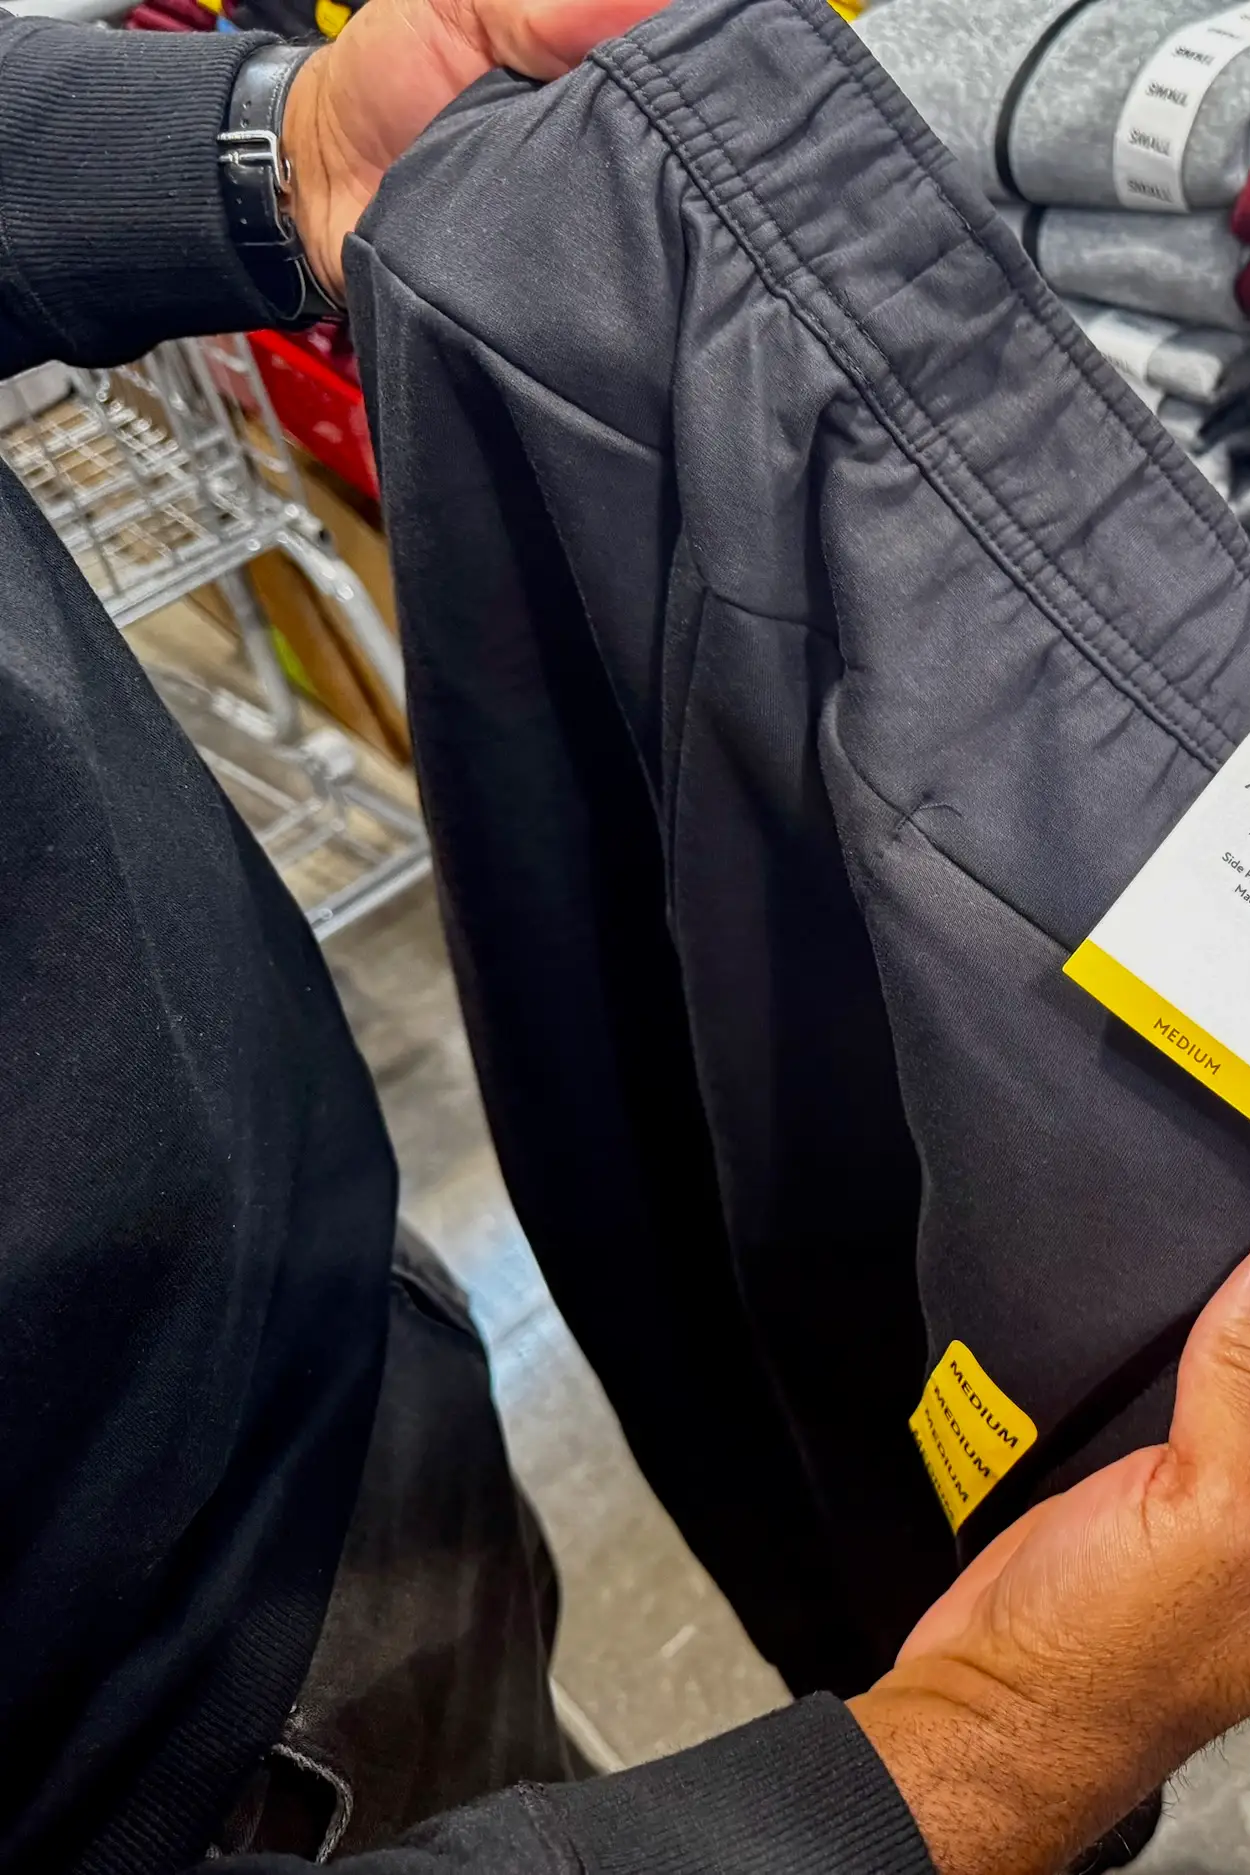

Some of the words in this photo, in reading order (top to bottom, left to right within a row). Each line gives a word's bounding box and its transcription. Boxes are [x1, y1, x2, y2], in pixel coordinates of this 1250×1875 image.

[1221, 851, 1245, 874] Side
[1153, 1017, 1222, 1075] MEDIUM
[933, 1386, 991, 1478] MEDIUM
[950, 1360, 1019, 1449] MEDIUM
[924, 1408, 969, 1503] MEDIUM
